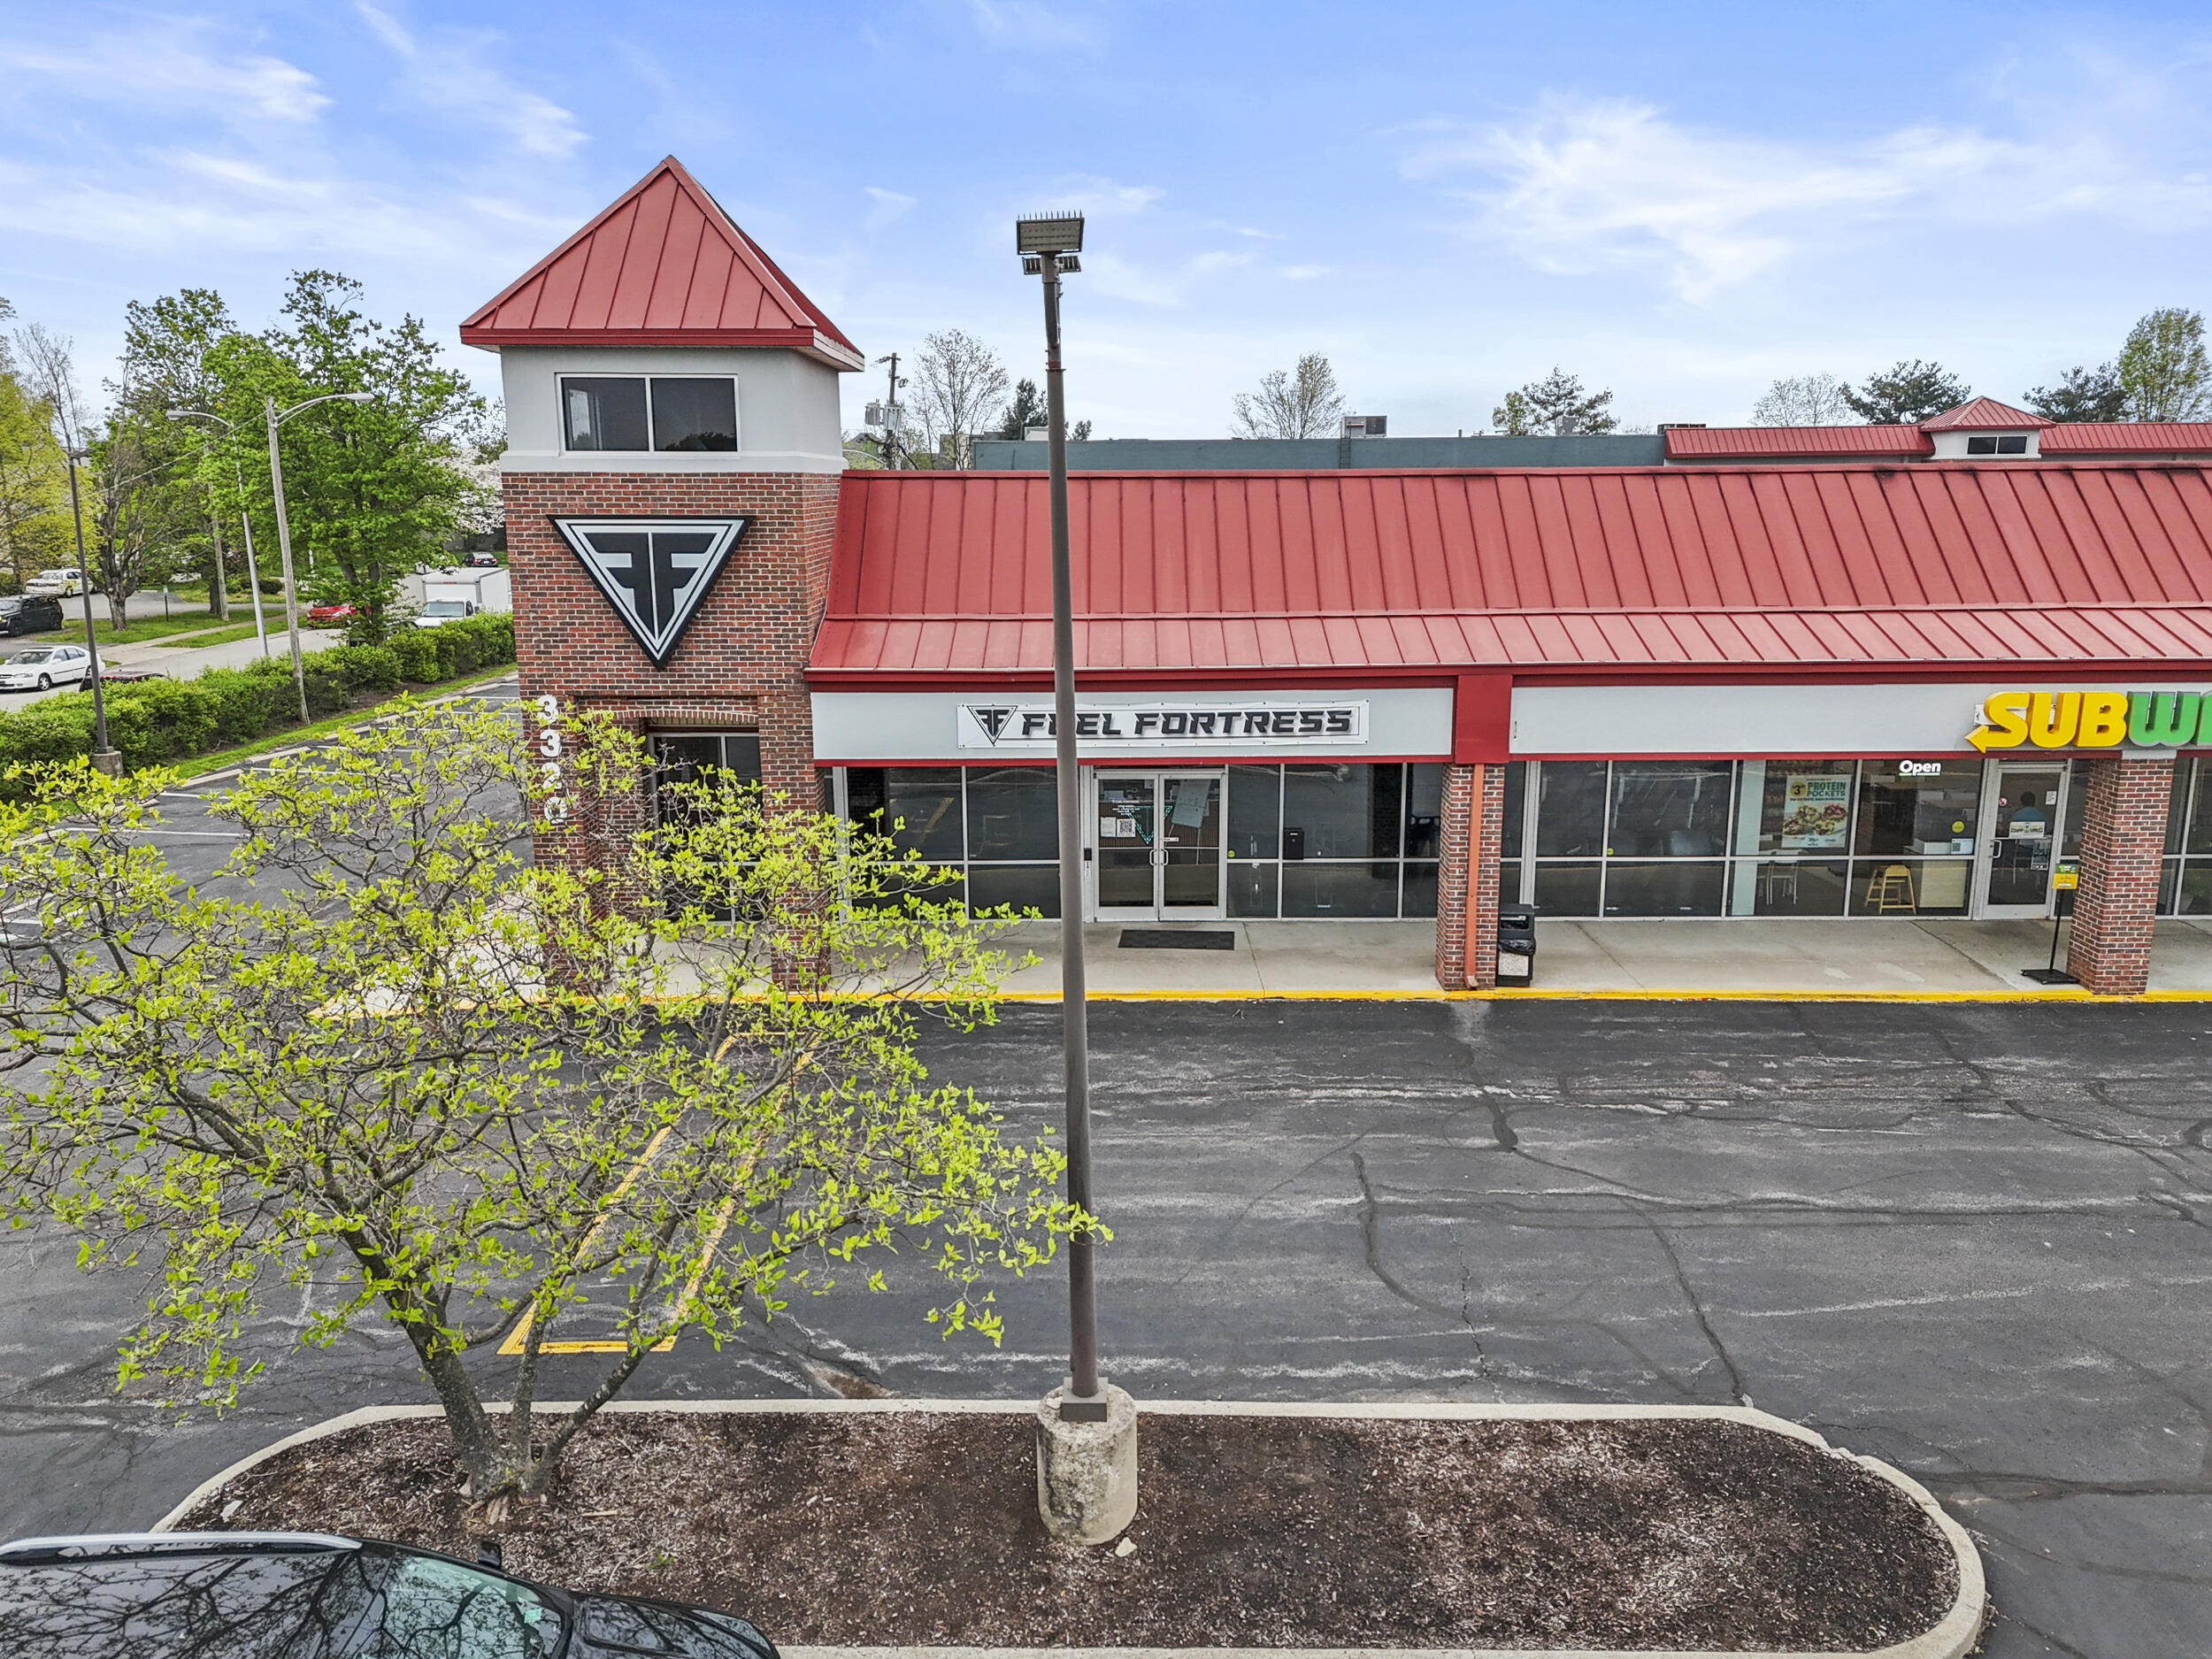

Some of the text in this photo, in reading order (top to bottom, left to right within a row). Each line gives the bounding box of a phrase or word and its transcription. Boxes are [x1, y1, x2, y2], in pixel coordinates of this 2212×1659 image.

[1134, 710, 1352, 736] FORTRESS
[1964, 690, 2212, 754] SUBW
[1900, 759, 1941, 776] Open
[1808, 781, 1847, 790] PROTEIN
